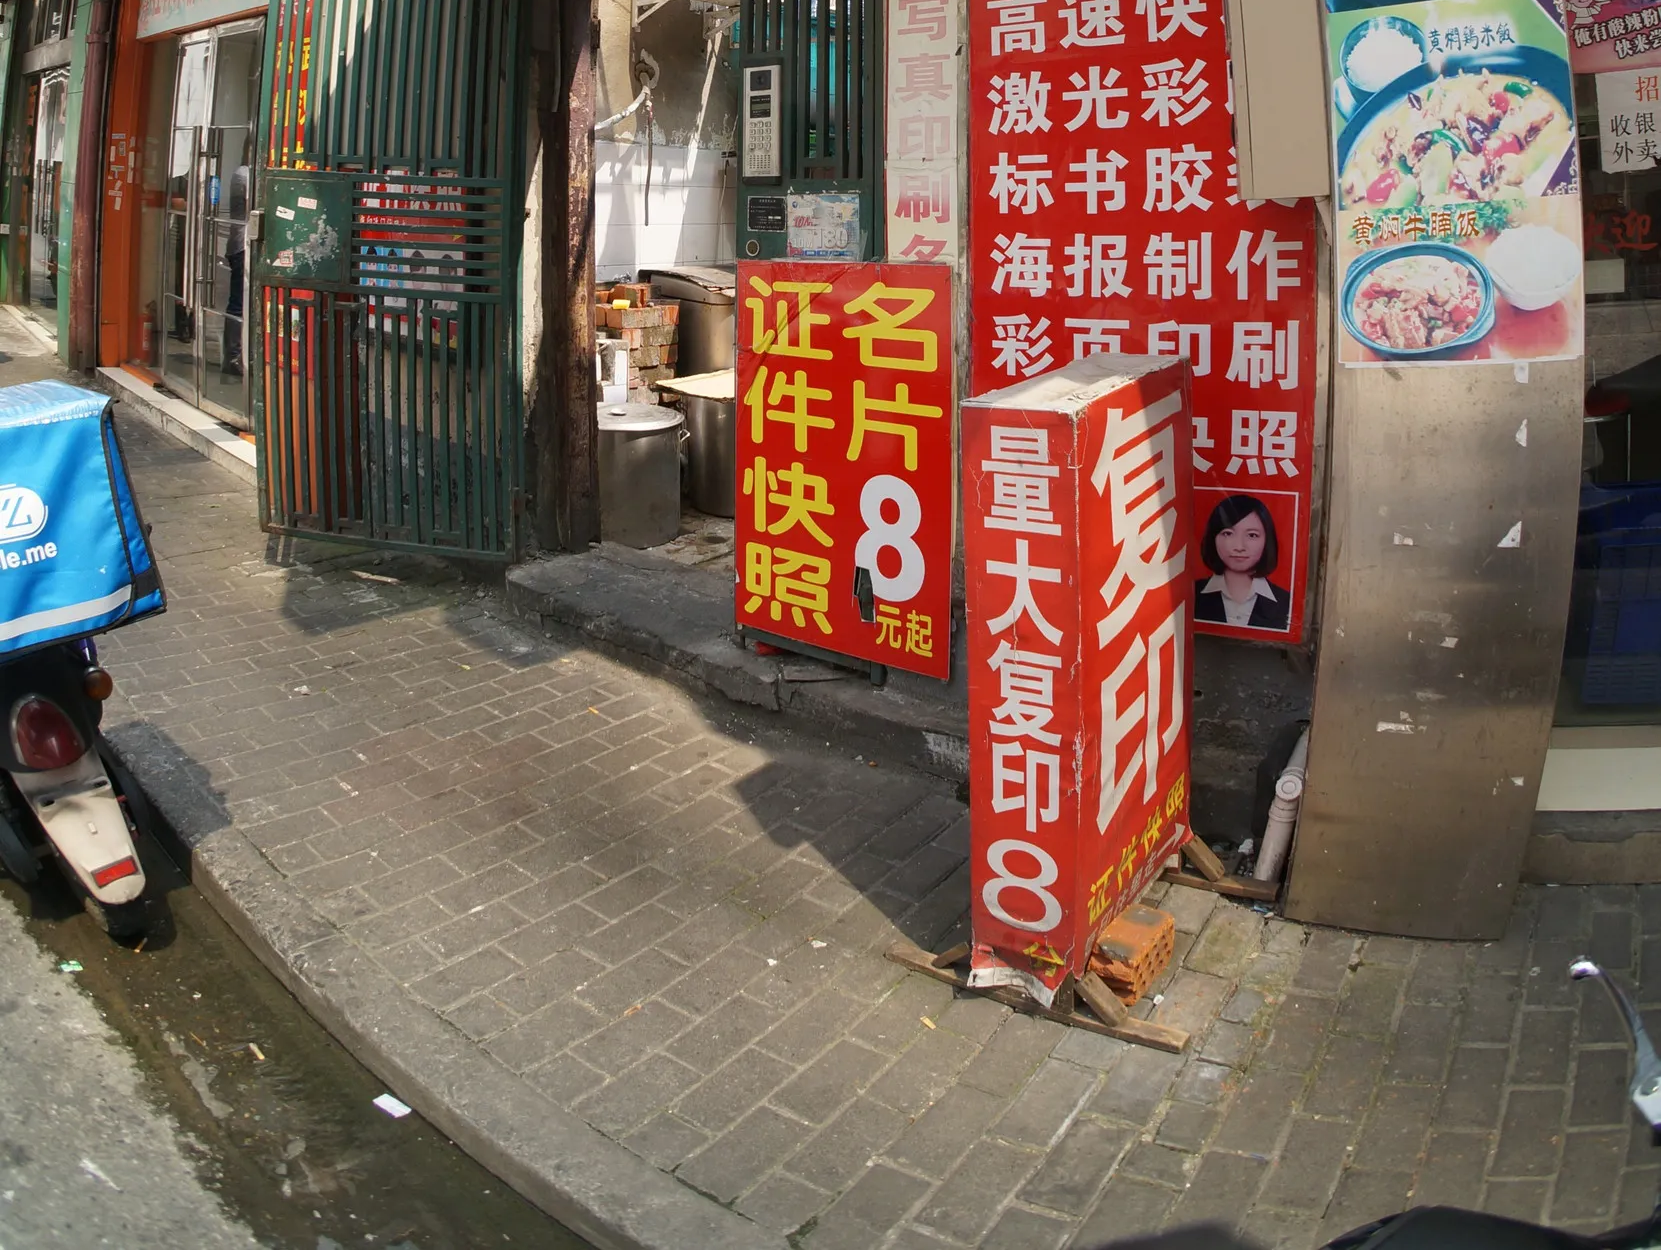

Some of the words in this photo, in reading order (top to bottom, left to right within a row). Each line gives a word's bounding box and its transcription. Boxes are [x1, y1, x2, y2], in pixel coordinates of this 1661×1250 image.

[1574, 7, 1661, 48] 俺有酸辣粉
[986, 57, 1235, 136] 激光彩
[1611, 111, 1657, 138] 收银
[1635, 75, 1660, 102] 招
[1613, 138, 1659, 165] 外卖
[990, 229, 1303, 301] 海报制作
[743, 275, 836, 635] 证件快照
[875, 604, 933, 658] 元起
[1090, 390, 1188, 836] 复印
[981, 425, 1065, 968] 量大复印8分
[1087, 771, 1185, 927] 证件快照
